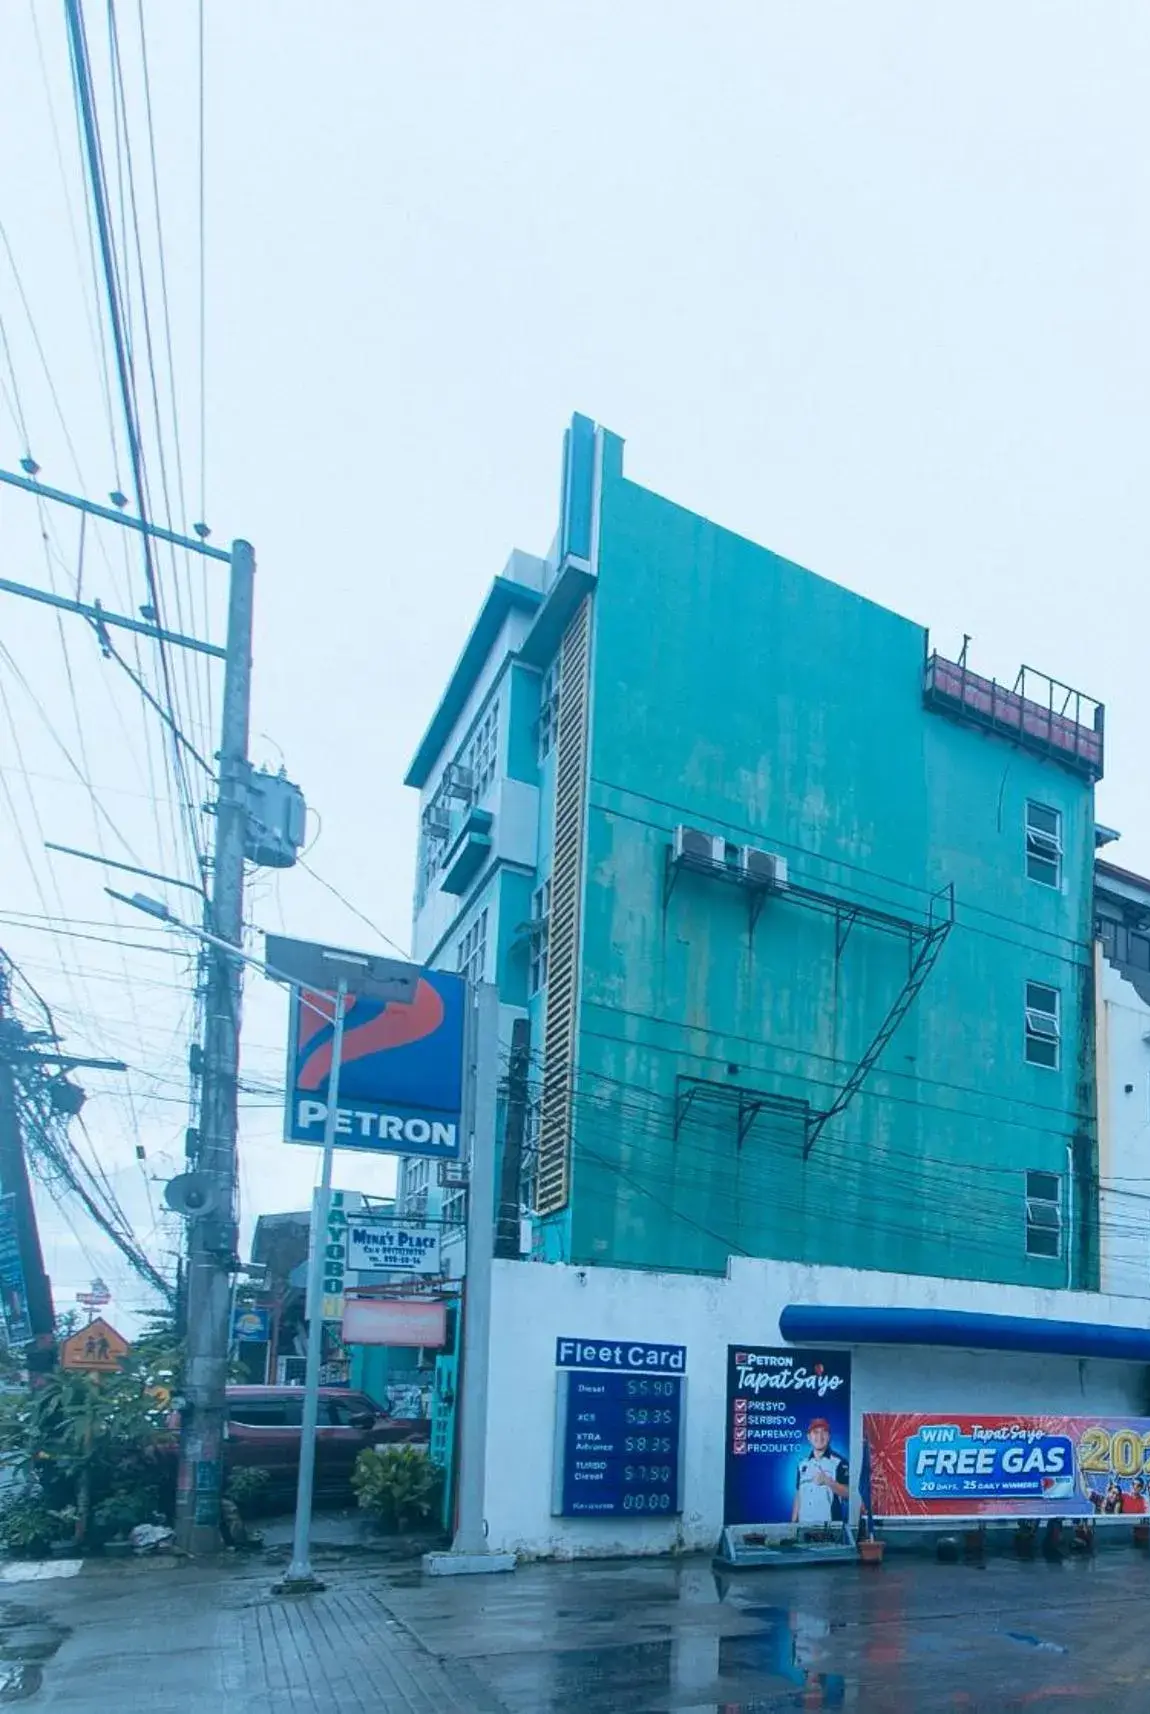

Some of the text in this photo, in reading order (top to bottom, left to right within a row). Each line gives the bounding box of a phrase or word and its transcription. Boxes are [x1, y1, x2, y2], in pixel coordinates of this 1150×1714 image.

[297, 1100, 456, 1147] PETRON
[560, 1342, 683, 1369] Fleet Card
[748, 1353, 793, 1367] PETRON
[748, 1400, 786, 1411] PRESYO
[747, 1415, 796, 1425] SERBISYO
[747, 1429, 802, 1439] PAPREMYO
[921, 1428, 955, 1443] WIN
[747, 1443, 801, 1453] PRODUKTO
[915, 1447, 1065, 1475] FREE GAS
[920, 1481, 935, 1492] 20
[963, 1480, 977, 1490] 25
